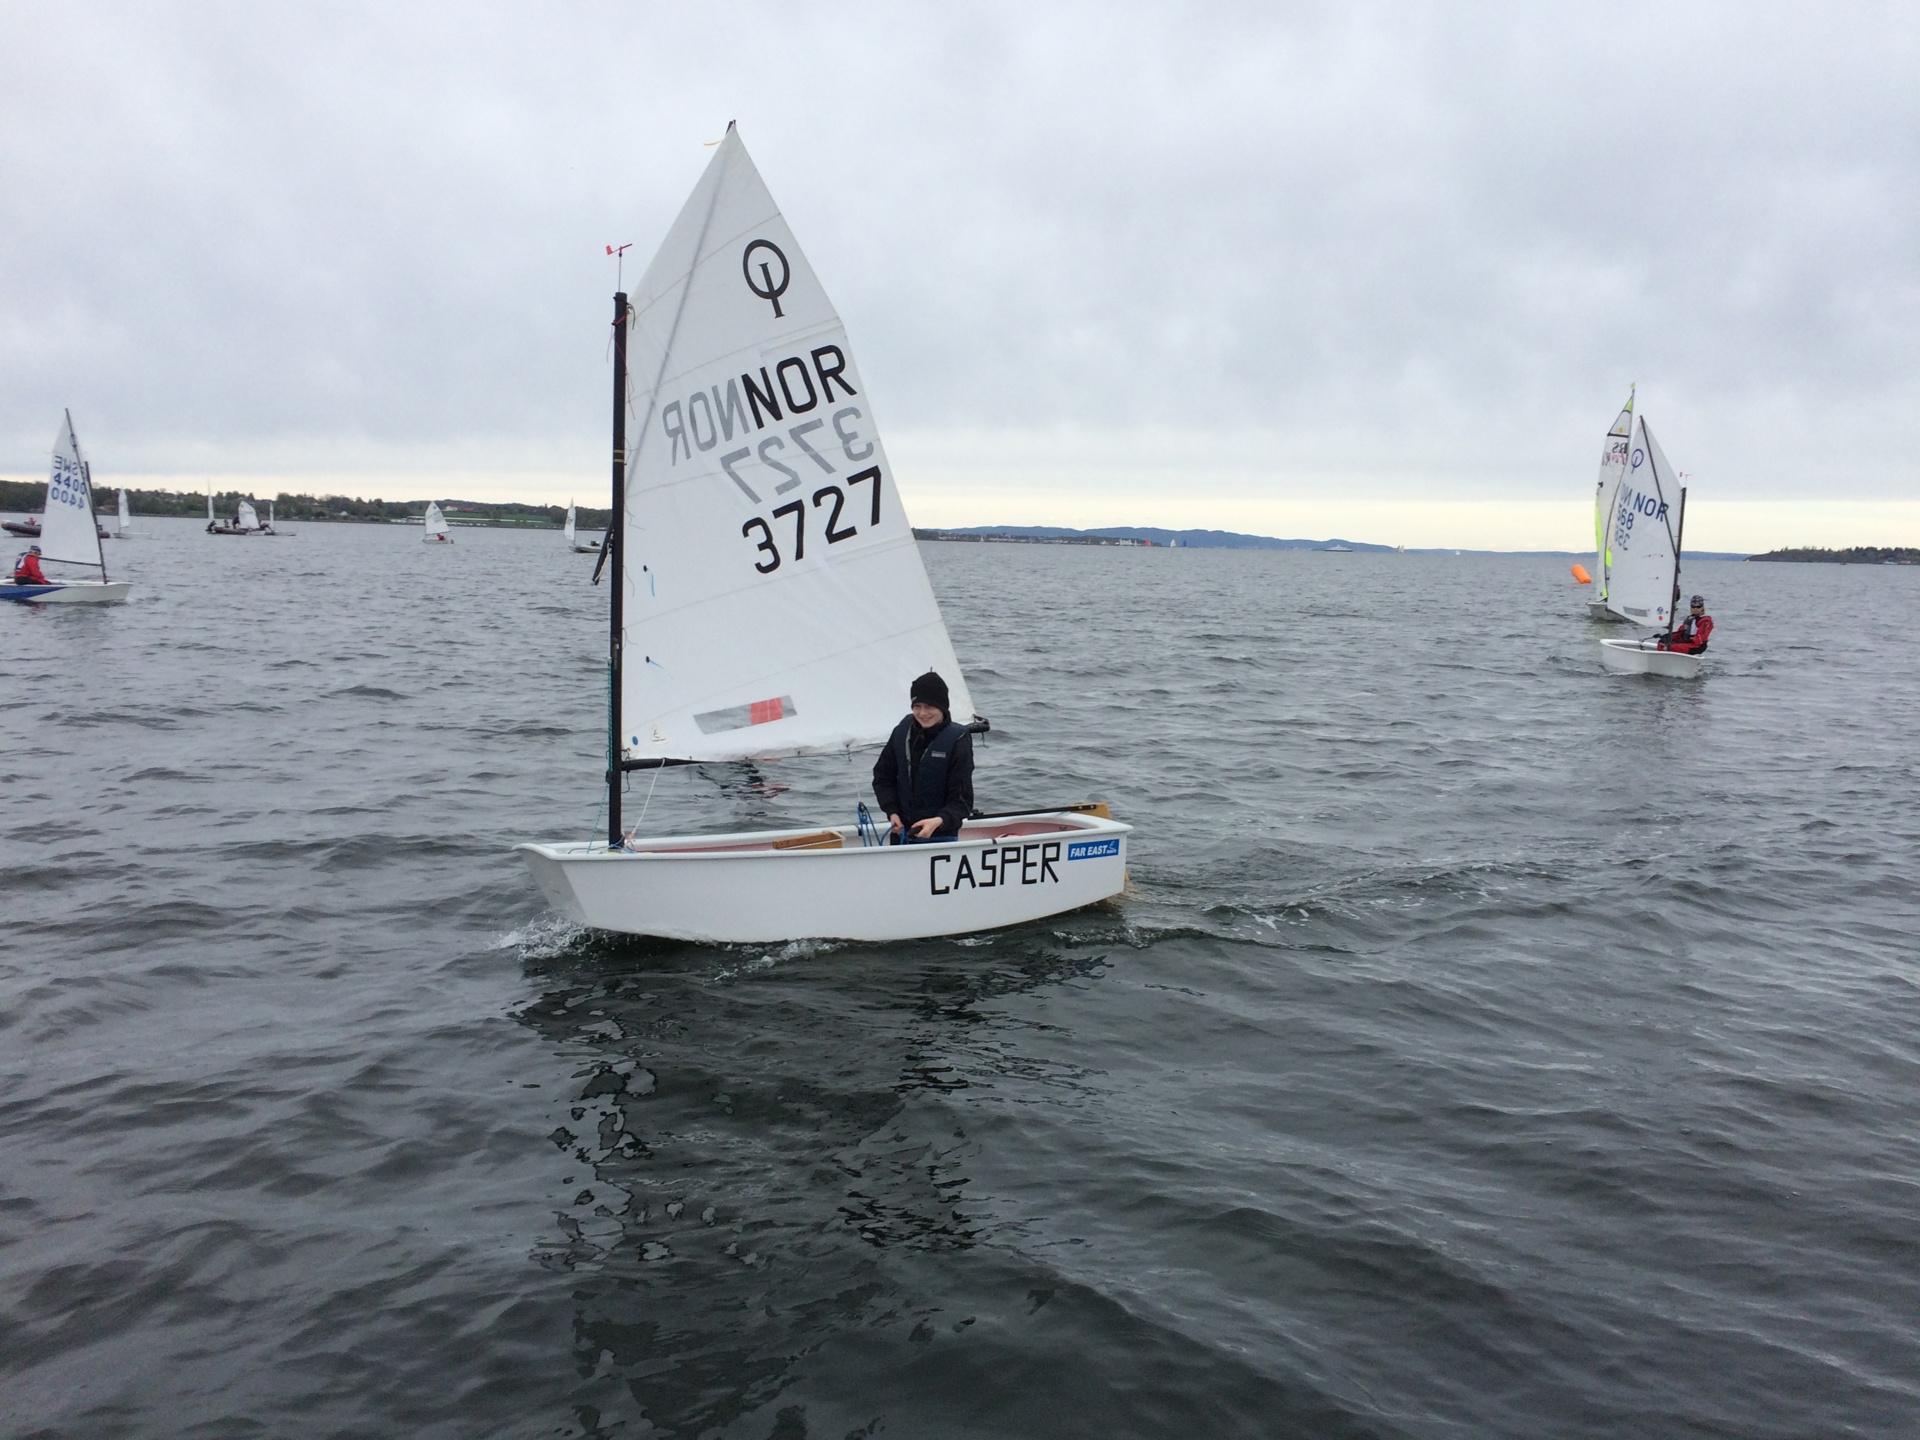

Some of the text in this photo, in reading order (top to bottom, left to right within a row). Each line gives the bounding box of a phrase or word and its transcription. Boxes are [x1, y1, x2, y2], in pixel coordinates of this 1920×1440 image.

[742, 345, 857, 429] NOR
[53, 473, 86, 495] 4400
[742, 465, 881, 573] 3727
[1633, 492, 1669, 522] NOR
[931, 842, 1060, 895] CASPER
[1070, 847, 1086, 857] FAR
[1087, 845, 1108, 856] EAST
